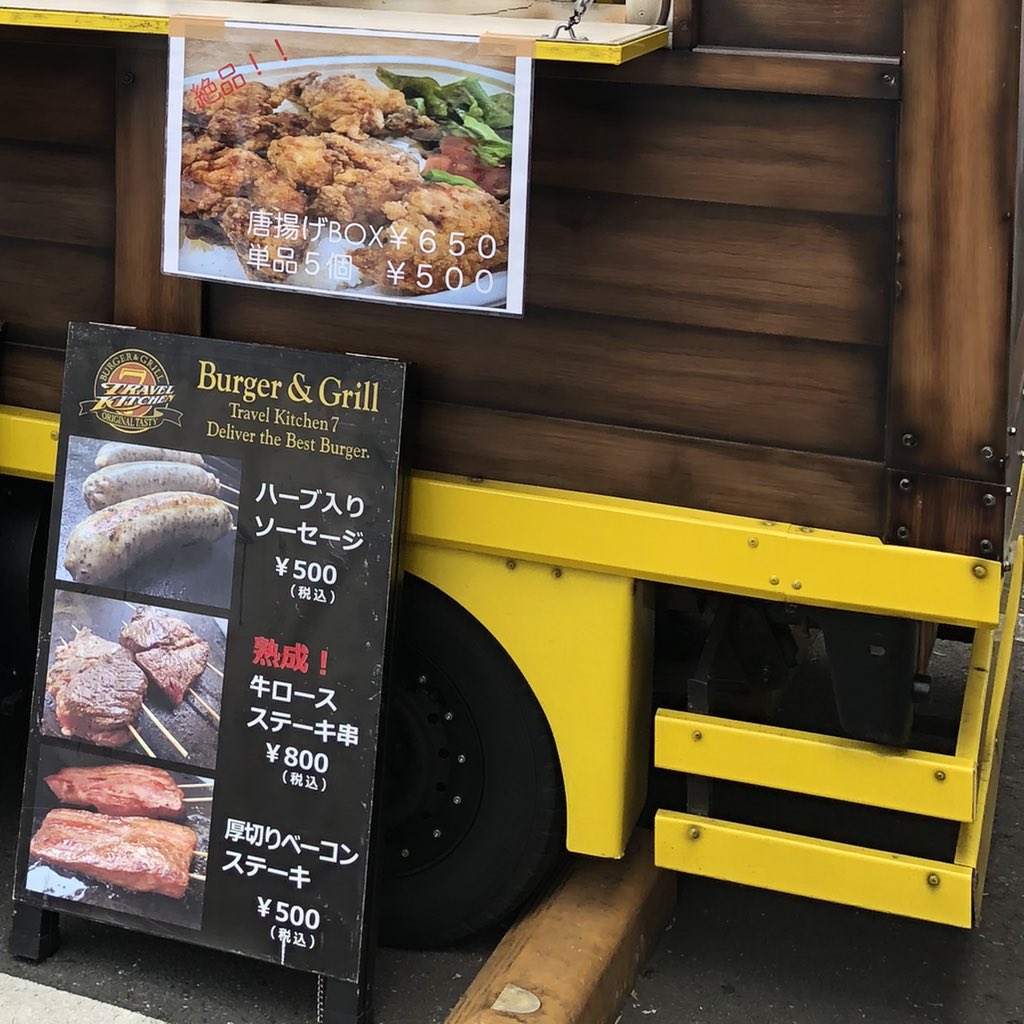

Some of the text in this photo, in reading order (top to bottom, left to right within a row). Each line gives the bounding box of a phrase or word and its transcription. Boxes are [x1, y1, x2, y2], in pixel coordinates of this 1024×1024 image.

[99, 353, 132, 381] BURGER
[140, 355, 164, 382] GRILL
[90, 394, 175, 411] KITCHEN
[101, 383, 175, 395] TRAVEL
[196, 360, 379, 412] Burger & Grill
[101, 412, 158, 427] ORIGINAL TASTY
[228, 403, 270, 423] Travel
[207, 421, 370, 460] Deliver the Best Burger.
[255, 482, 365, 518] ハーブ入り
[255, 515, 364, 551] ソーセージ
[275, 556, 337, 585] ¥500
[290, 584, 336, 604] (税込)
[252, 636, 329, 676] 熟成！
[250, 675, 338, 712] 牛ロース
[247, 707, 359, 747] ステーキ串
[265, 742, 329, 773] ¥800
[282, 770, 327, 792] (税込)
[224, 817, 359, 866] 厚切りベーコン
[222, 850, 311, 889] ステーキ
[257, 896, 320, 930] ¥500
